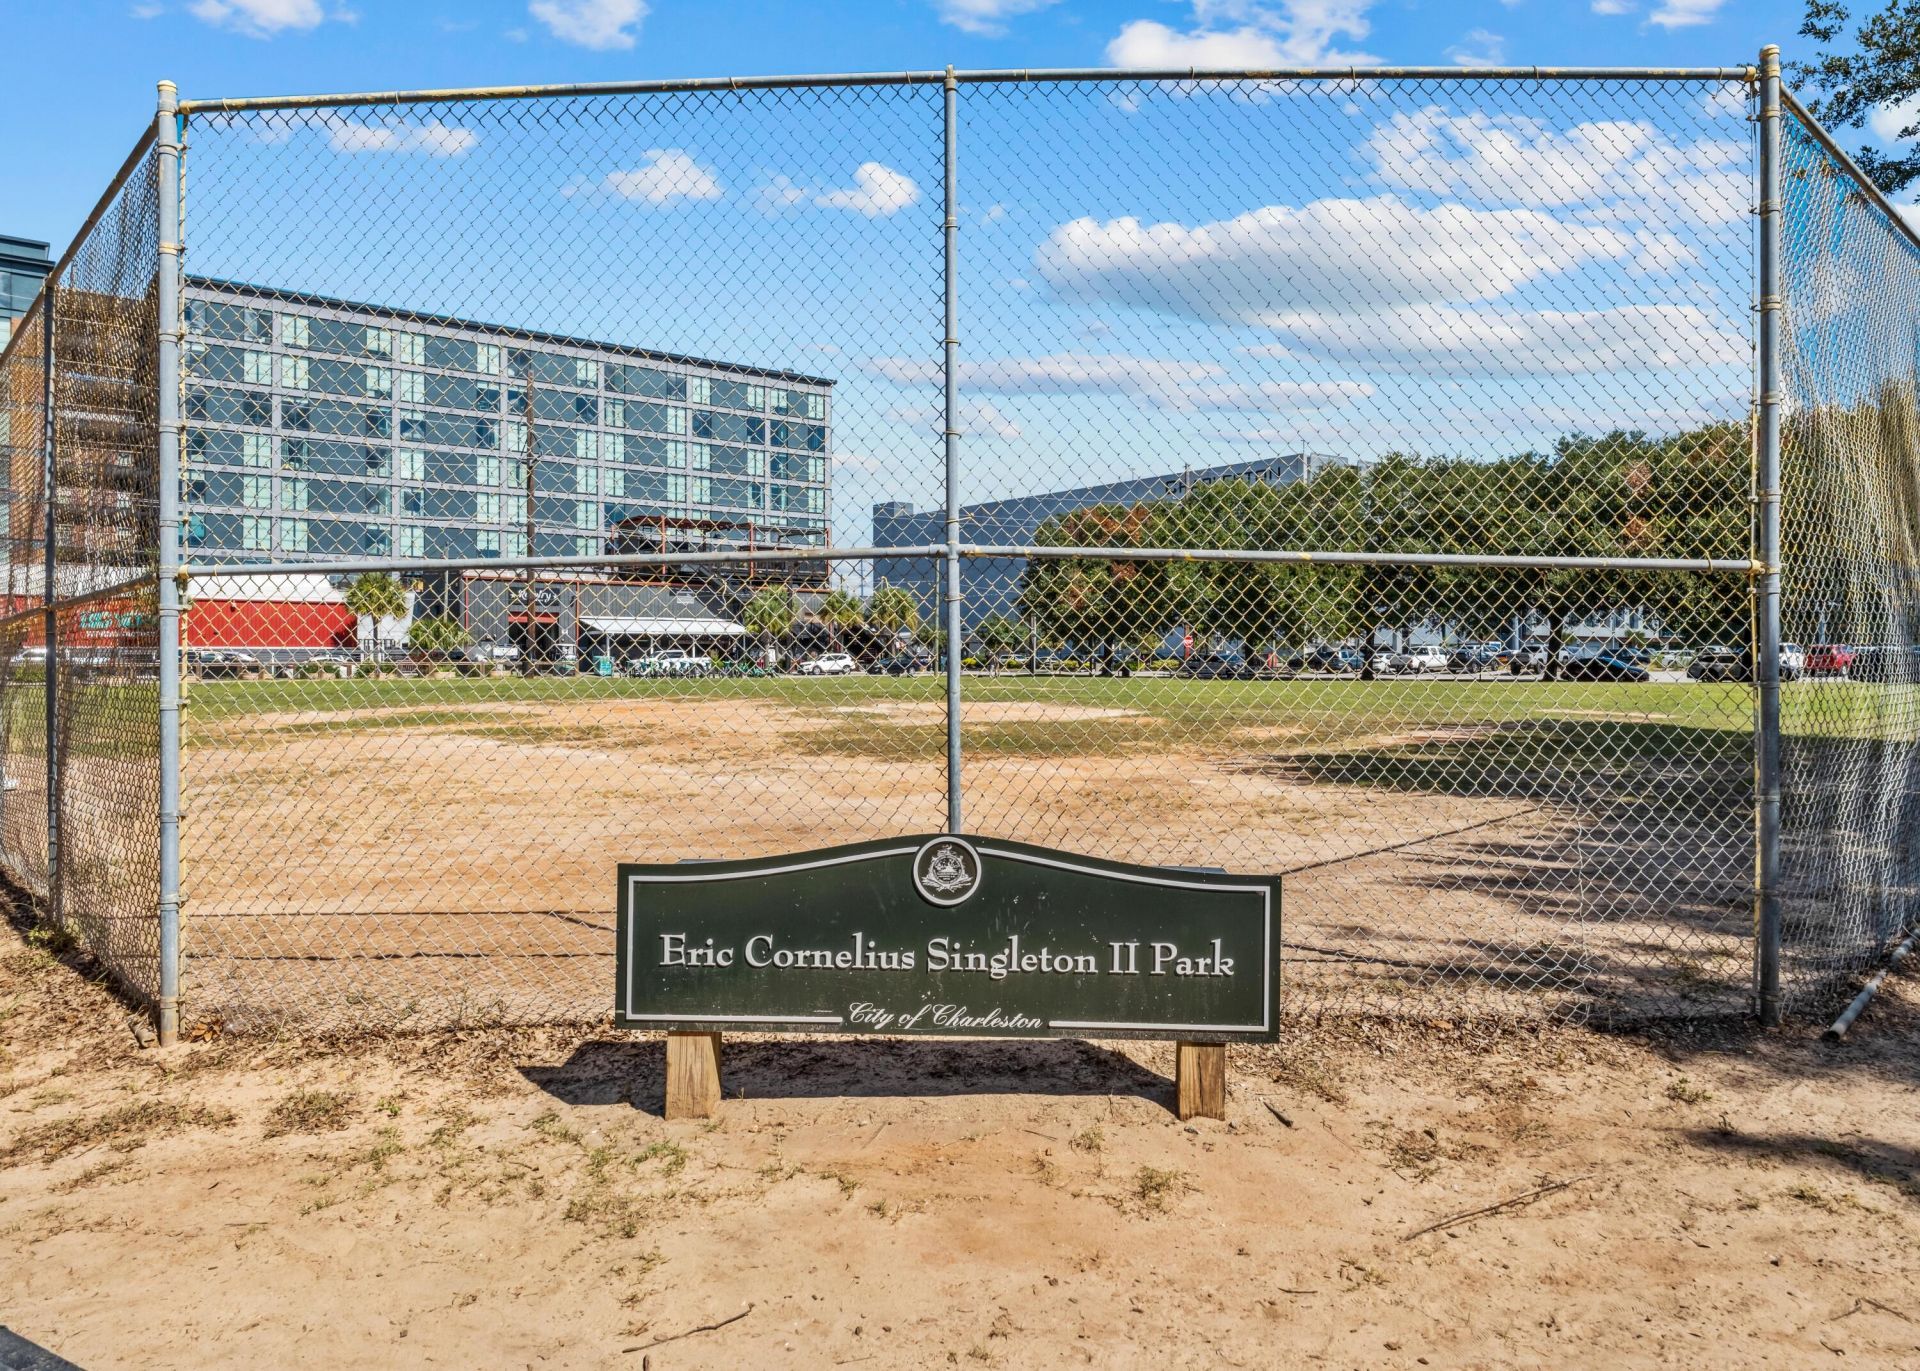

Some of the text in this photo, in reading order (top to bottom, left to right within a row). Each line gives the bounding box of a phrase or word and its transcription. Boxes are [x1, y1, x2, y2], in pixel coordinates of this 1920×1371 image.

[659, 931, 1235, 979] Eric Cornelius Singleton II Park
[849, 1002, 1043, 1030] City of Charleston
